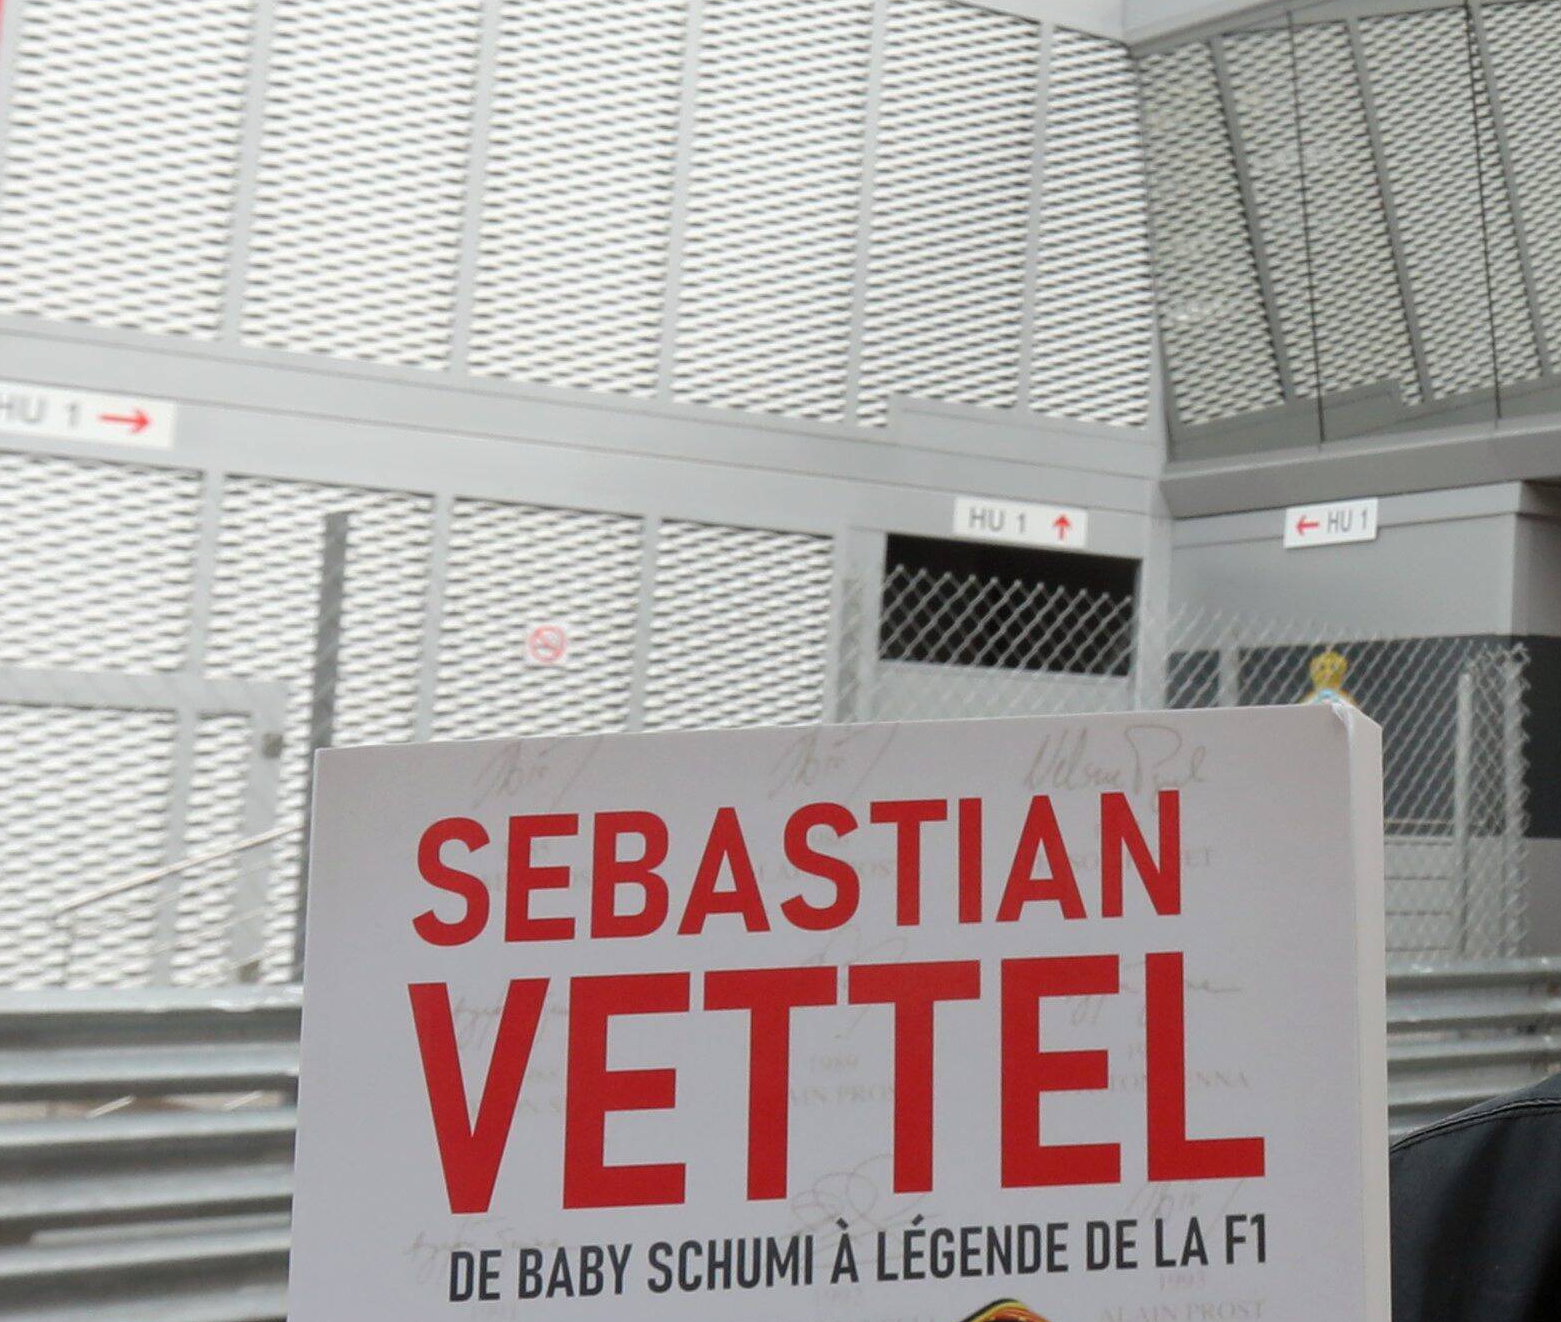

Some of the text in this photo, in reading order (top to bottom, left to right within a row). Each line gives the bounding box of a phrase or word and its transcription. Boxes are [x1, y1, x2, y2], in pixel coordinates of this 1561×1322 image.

[969, 506, 1028, 535] HU 1
[1327, 508, 1369, 533] HU 1
[413, 789, 1183, 948] SEBASTIAN
[408, 951, 1267, 1216] VETTEL
[450, 1250, 503, 1303] DE
[519, 1243, 634, 1300] BABY
[647, 1235, 815, 1295] SCHUMI
[831, 1217, 860, 1285] À
[877, 1214, 1070, 1283] LÉGENDE
[1086, 1220, 1139, 1272] DE
[1154, 1217, 1210, 1269] LA
[1225, 1213, 1267, 1266] F1
[1185, 1299, 1267, 1322] PROST
